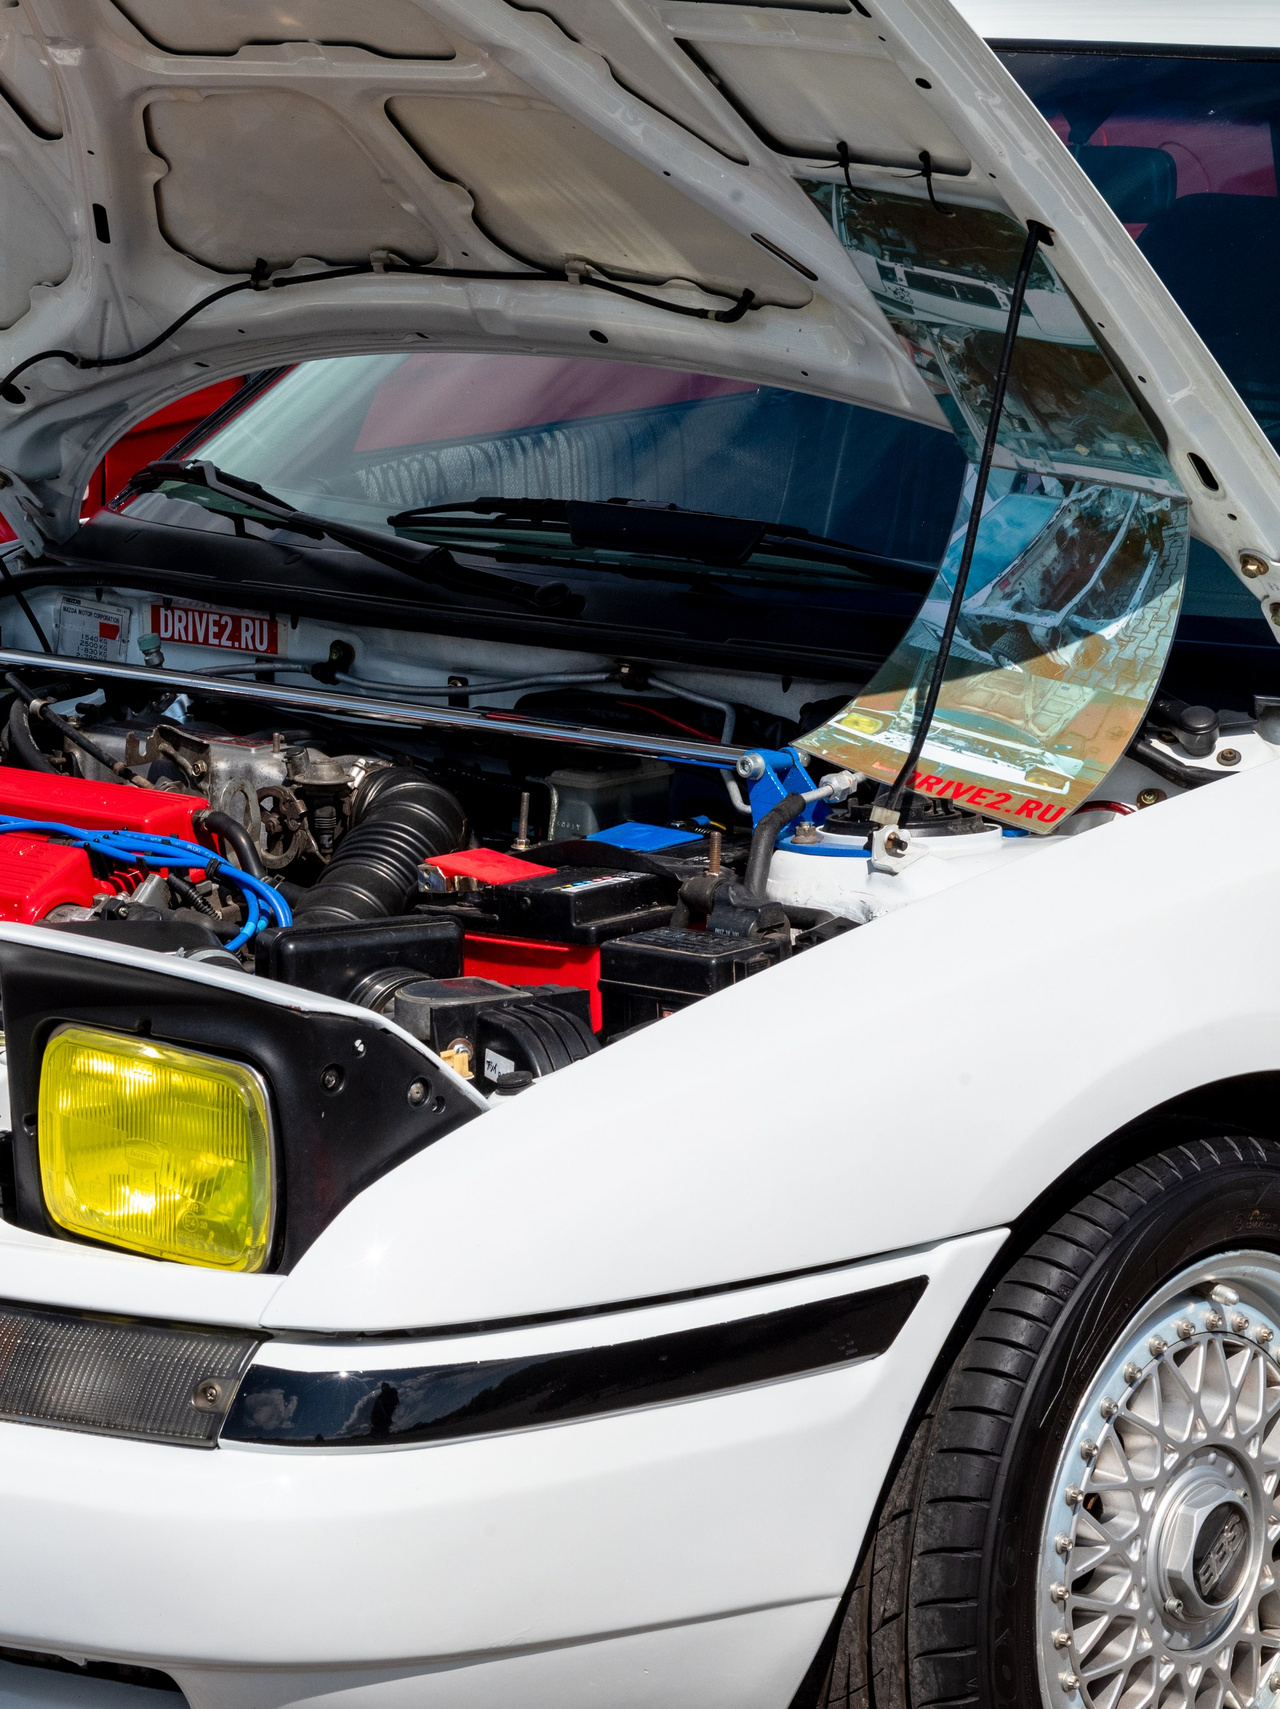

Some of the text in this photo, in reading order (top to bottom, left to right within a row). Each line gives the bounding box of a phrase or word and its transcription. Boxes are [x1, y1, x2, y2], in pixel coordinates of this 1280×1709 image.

[62, 606, 120, 624] MAZDA MOTOR CORPORATION
[159, 607, 269, 652] DRIVE2.RU
[79, 640, 98, 649] 2500
[81, 633, 99, 643] 1540
[77, 646, 98, 656] 1-830
[1197, 1512, 1247, 1597] BBS
